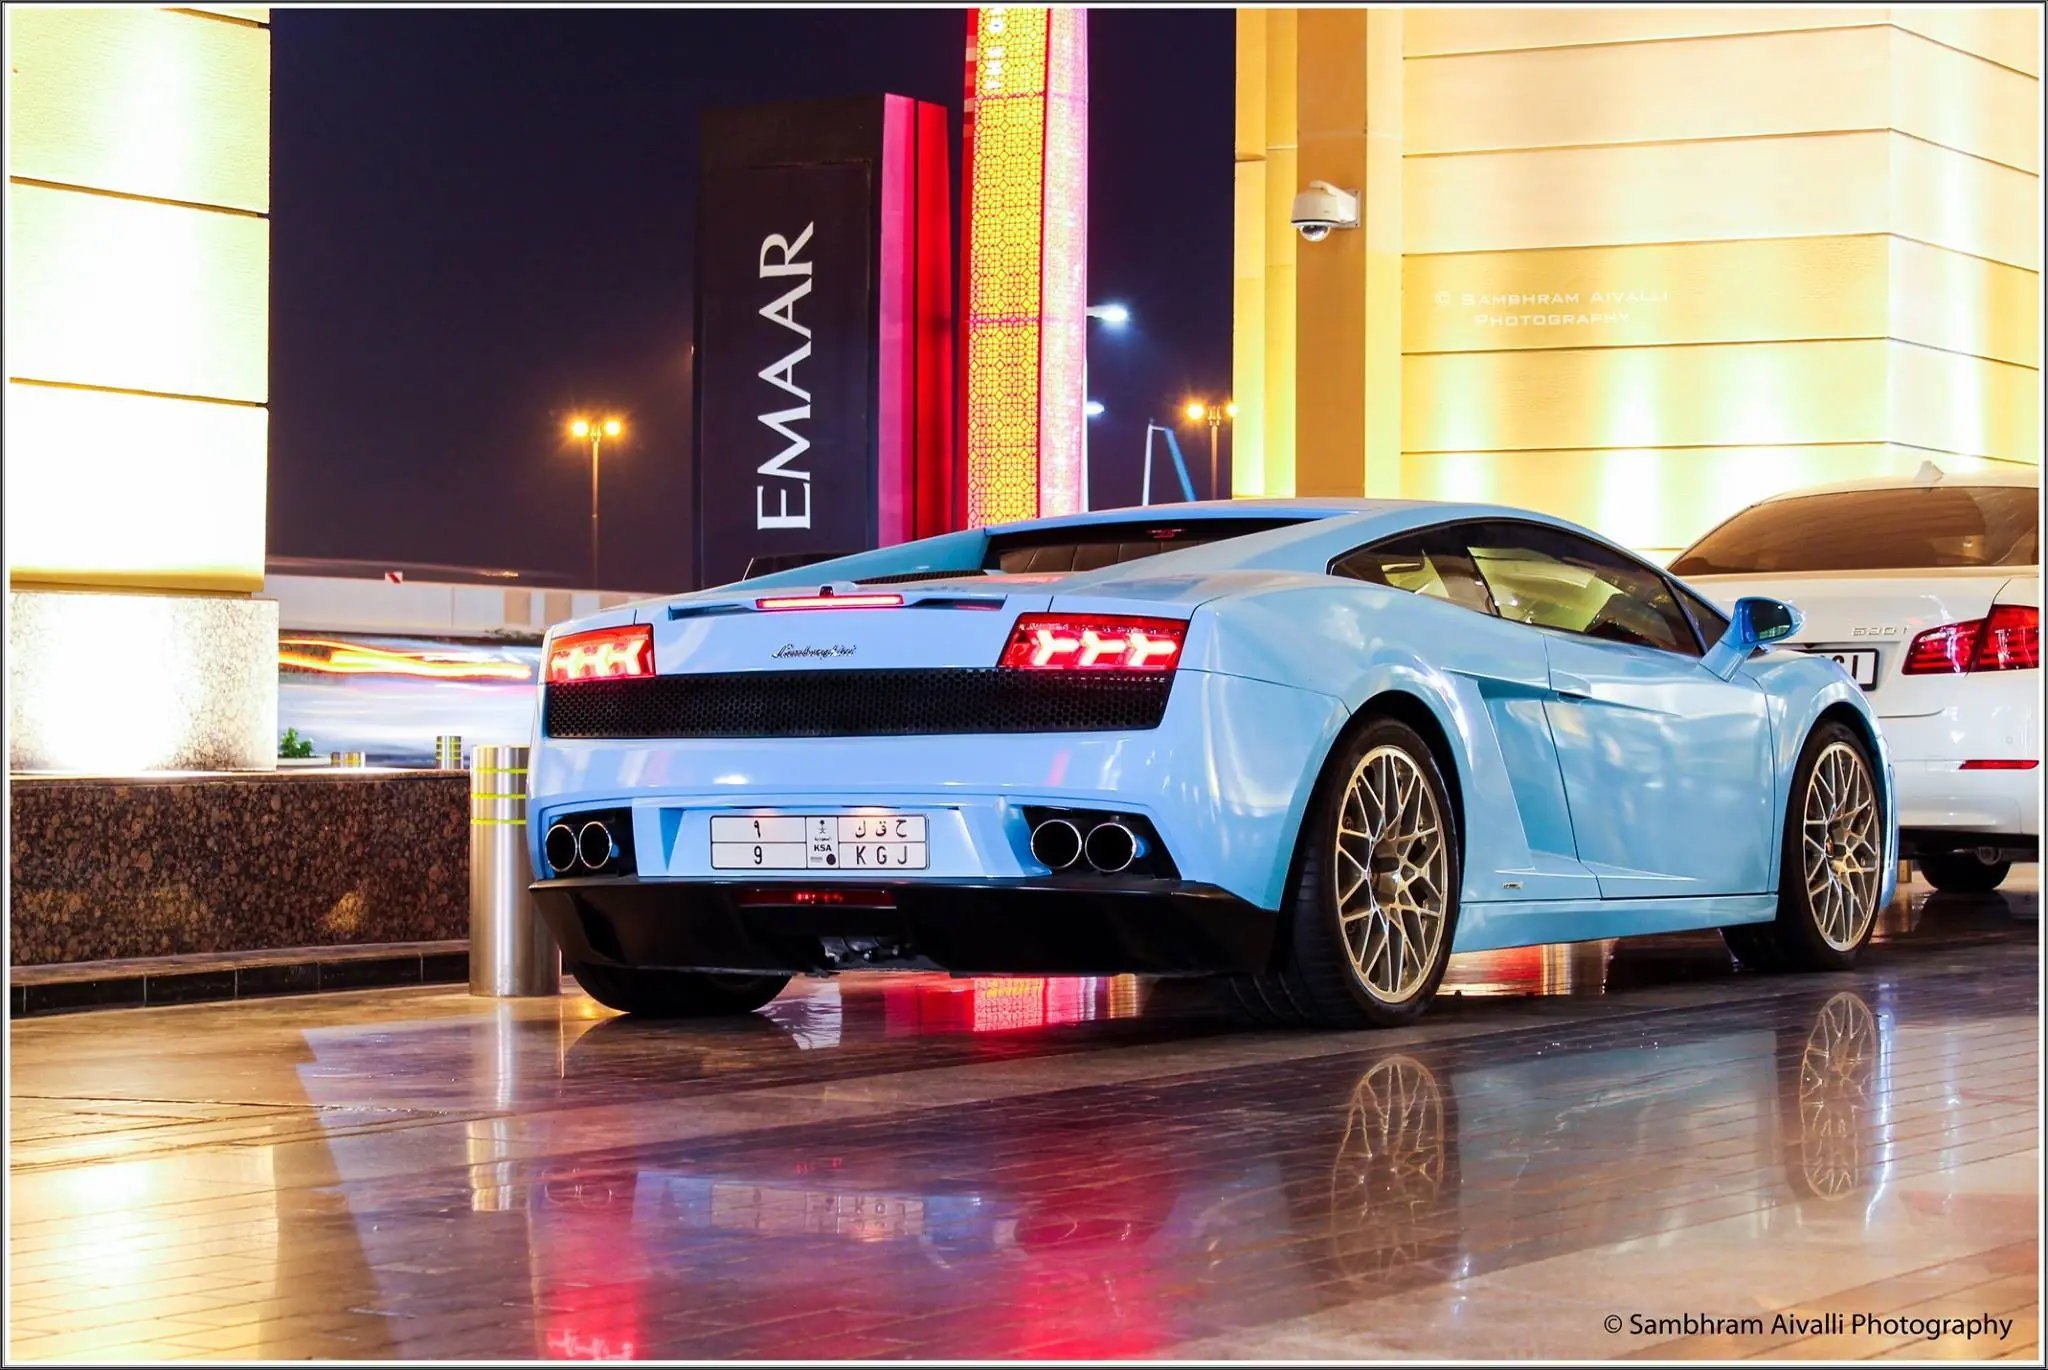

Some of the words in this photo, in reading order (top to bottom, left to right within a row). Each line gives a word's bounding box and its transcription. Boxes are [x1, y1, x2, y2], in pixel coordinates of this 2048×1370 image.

[756, 221, 814, 531] EMAAR
[754, 846, 763, 865] 9
[813, 844, 832, 852] KSA
